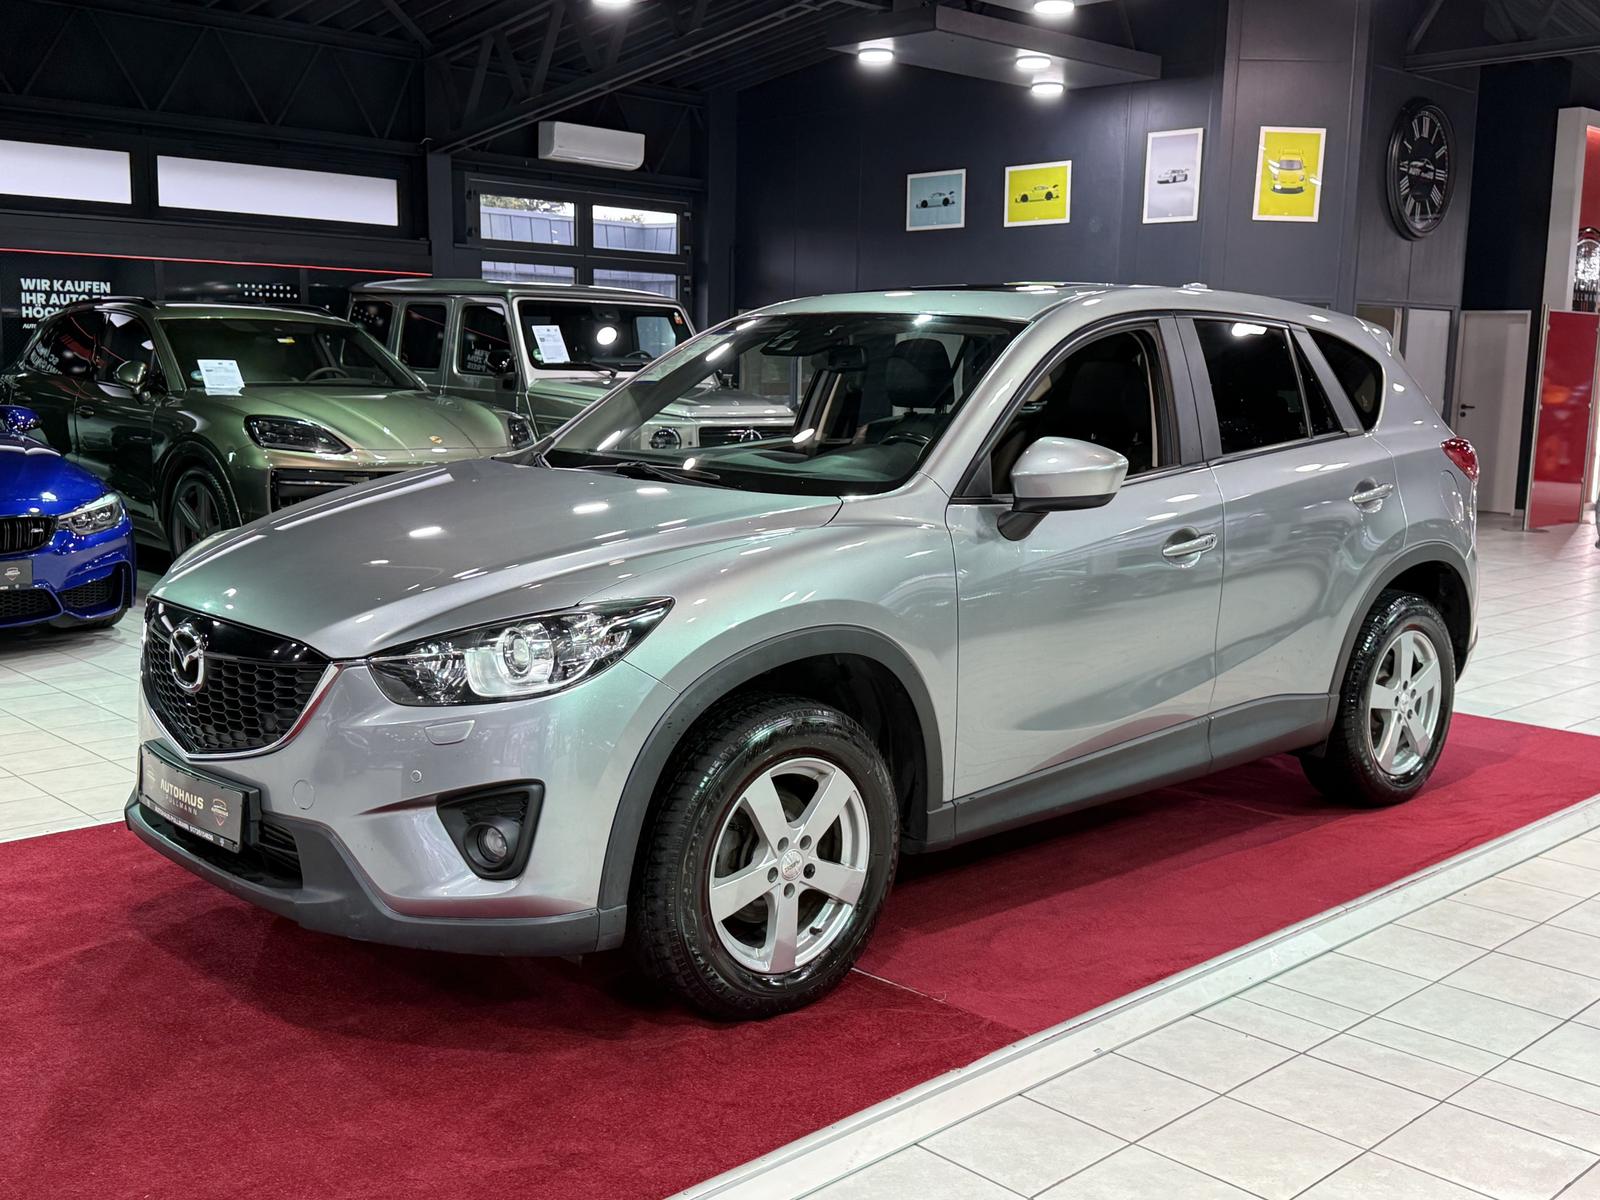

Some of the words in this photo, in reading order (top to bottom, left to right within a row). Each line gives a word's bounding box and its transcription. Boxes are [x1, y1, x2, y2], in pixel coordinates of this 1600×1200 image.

[20, 278, 51, 291] WIR
[53, 280, 111, 294] KAUFEN
[21, 292, 46, 305] IHR
[160, 778, 204, 810] AUTOHAUS
